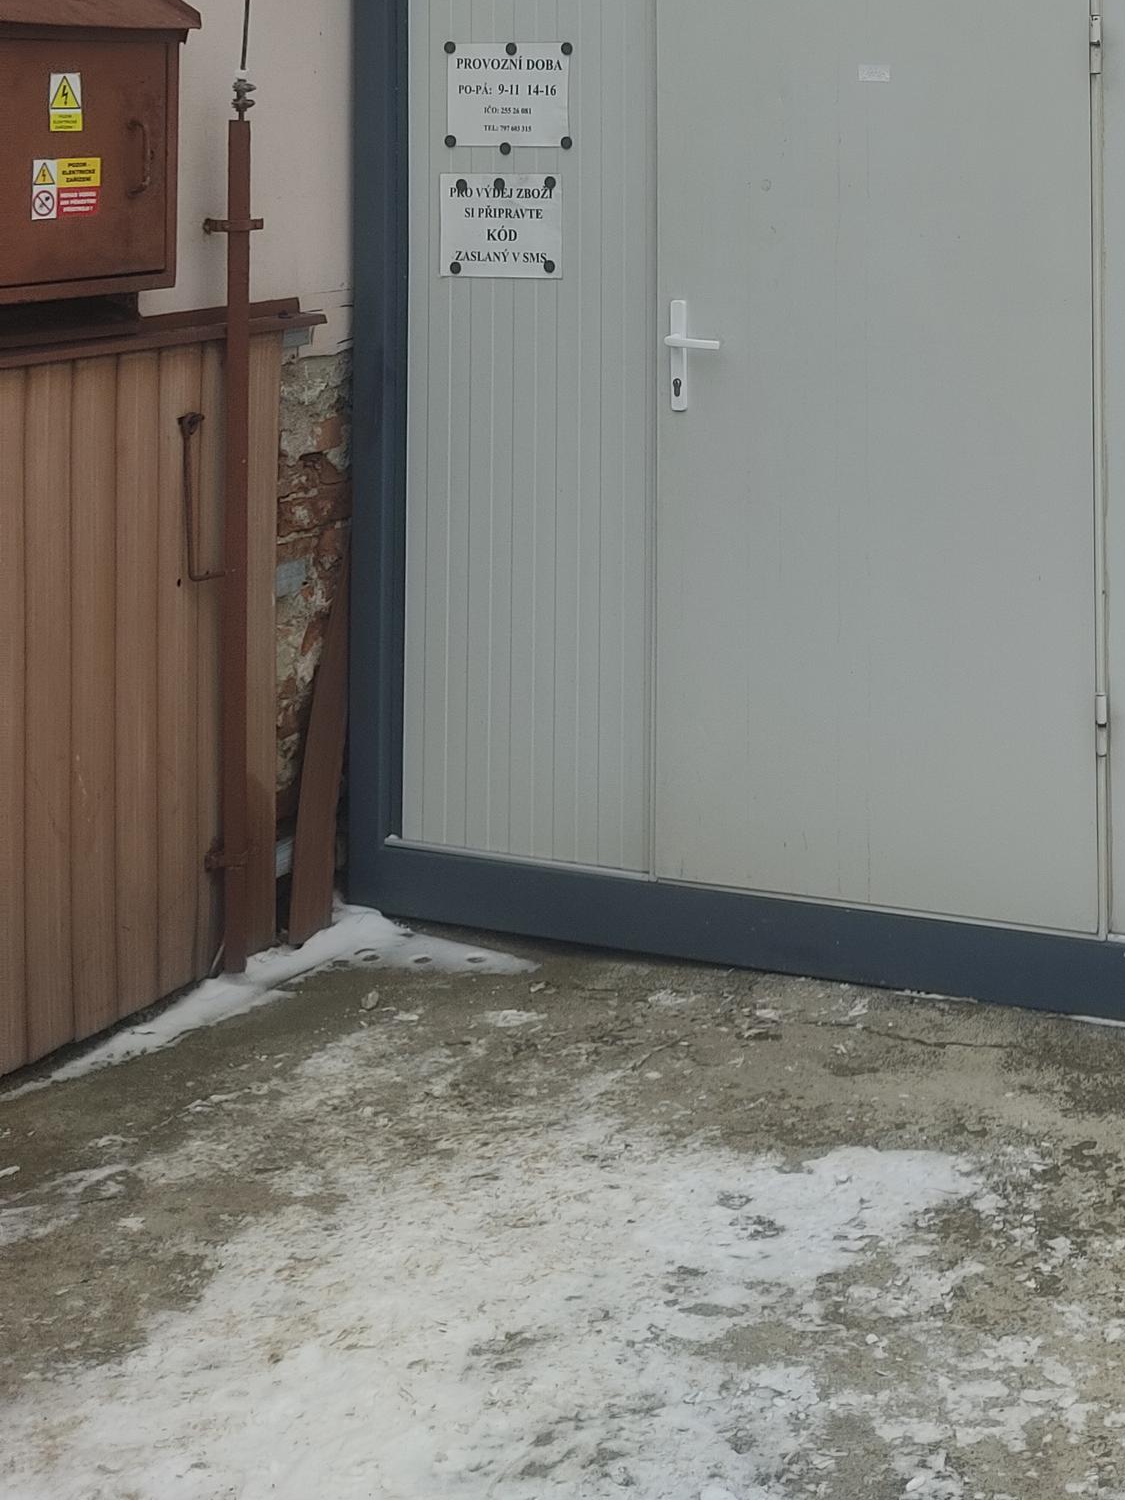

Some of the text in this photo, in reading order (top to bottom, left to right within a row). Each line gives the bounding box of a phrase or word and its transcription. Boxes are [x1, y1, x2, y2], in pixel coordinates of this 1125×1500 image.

[456, 55, 563, 71] PROVOZNÍ DOBA
[458, 82, 557, 96] PO-PÁ: 9-11 14-16
[464, 205, 543, 219] SI PŘIPRAVTE
[486, 225, 518, 242] KÓD
[455, 248, 547, 264] ZASLANÝ V SMS
